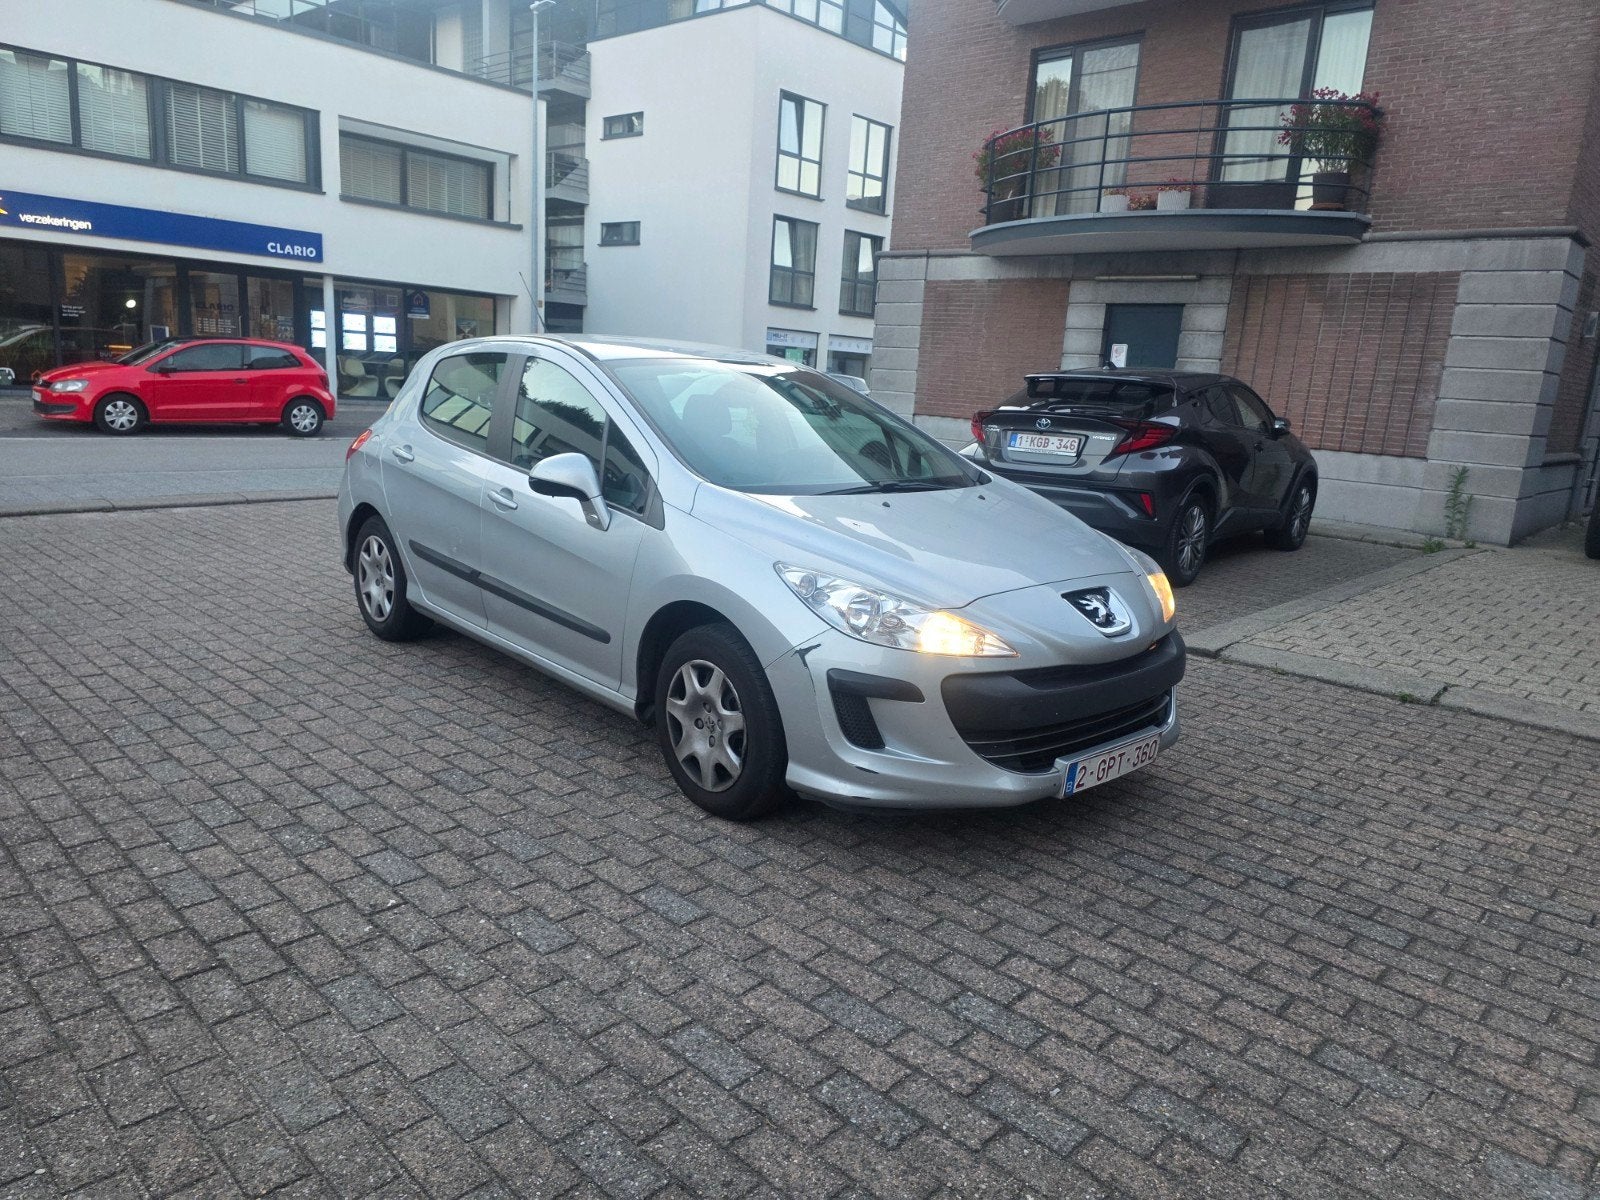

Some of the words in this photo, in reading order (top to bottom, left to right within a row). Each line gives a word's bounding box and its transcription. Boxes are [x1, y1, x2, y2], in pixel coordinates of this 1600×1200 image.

[19, 213, 92, 231] verzekeringen
[267, 242, 316, 258] CLARIO
[1076, 740, 1158, 789] 2-GPT-360
